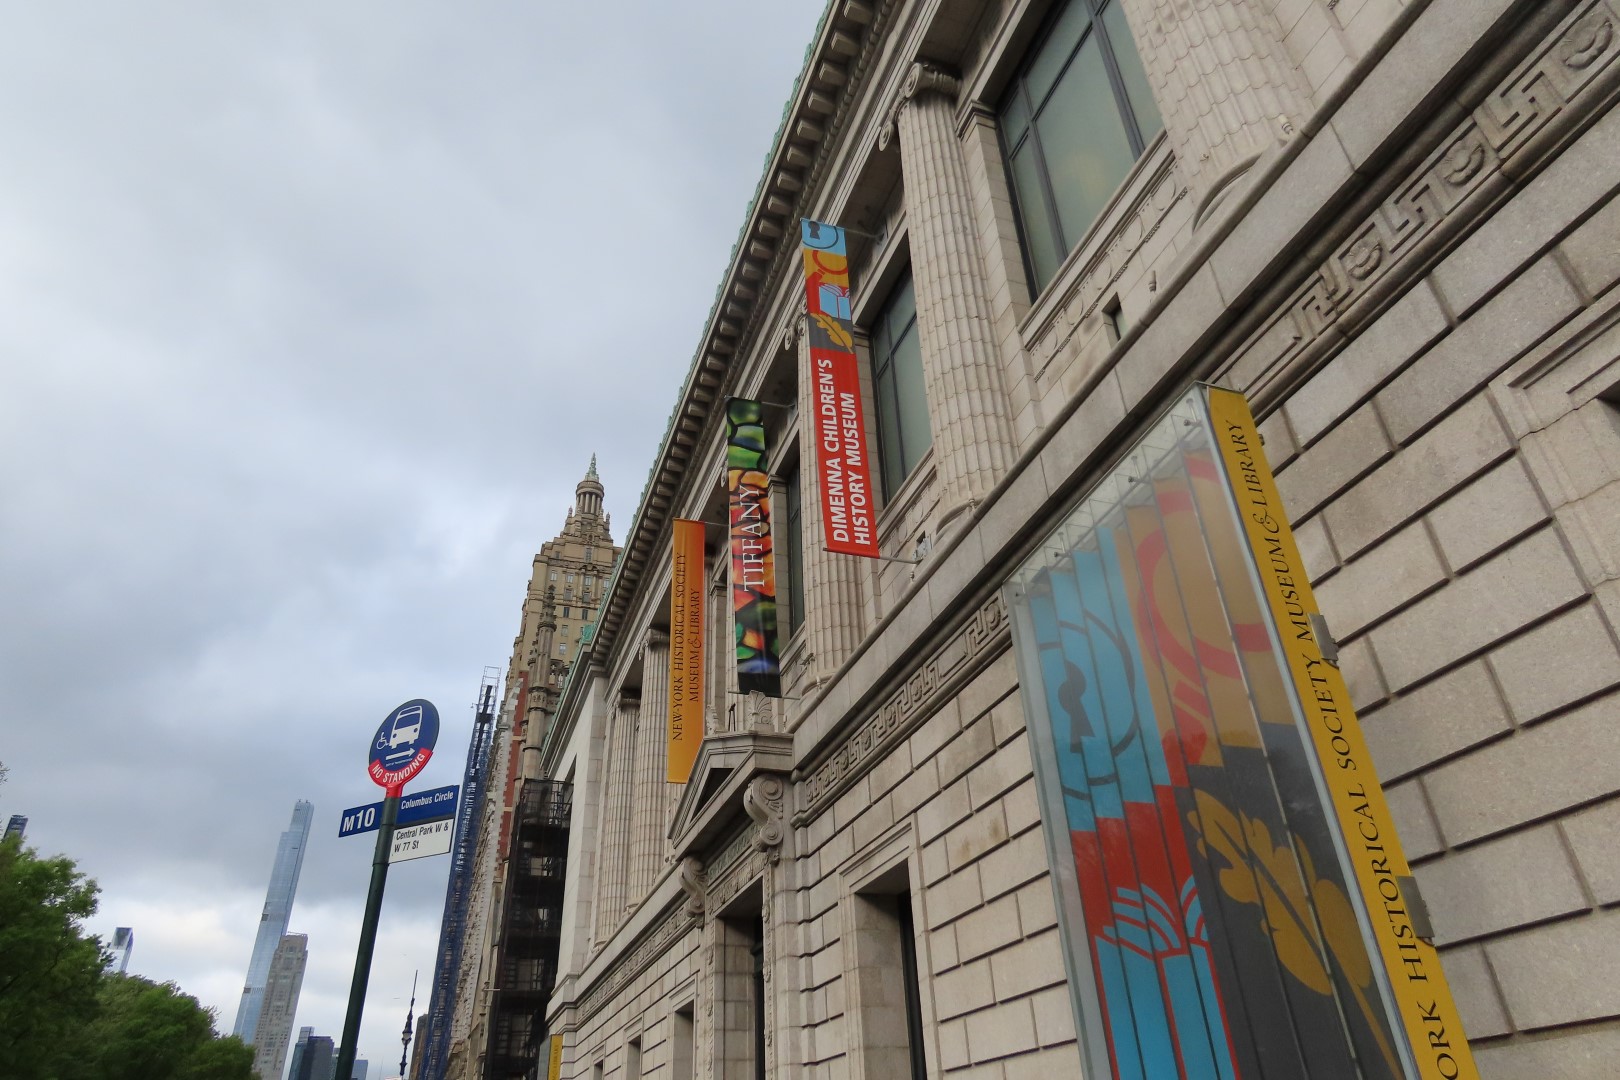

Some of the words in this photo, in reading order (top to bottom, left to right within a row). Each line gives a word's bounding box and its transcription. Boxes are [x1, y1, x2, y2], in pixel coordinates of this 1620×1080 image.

[818, 359, 841, 453] CHILDREN'S
[839, 392, 862, 467] MUSEUM
[1225, 419, 1268, 507] LIBRARY
[826, 457, 849, 543] DIMENNA
[847, 470, 871, 545] HISTORY
[1252, 508, 1280, 534] &
[740, 484, 765, 592] TIFFANY
[675, 552, 686, 599] SOCIETY
[1263, 535, 1314, 643] MUSEUM
[673, 602, 685, 671] HISTORICAL
[689, 588, 700, 635] LIBRARY
[672, 676, 684, 741] NEW-YORK
[689, 650, 700, 702] MUSEUM
[1302, 652, 1357, 771] SOCIETY
[371, 763, 384, 779] NO
[382, 753, 426, 783] STANDING
[401, 796, 433, 810] Columbus
[434, 790, 454, 803] Circle
[342, 807, 376, 832] M10
[394, 843, 400, 853] W
[402, 841, 411, 851] 77
[412, 840, 420, 850] St
[396, 828, 418, 841] Central
[418, 825, 433, 836] Park
[435, 823, 442, 833] W
[443, 822, 449, 832] &
[1347, 782, 1429, 983] HISTORICAL
